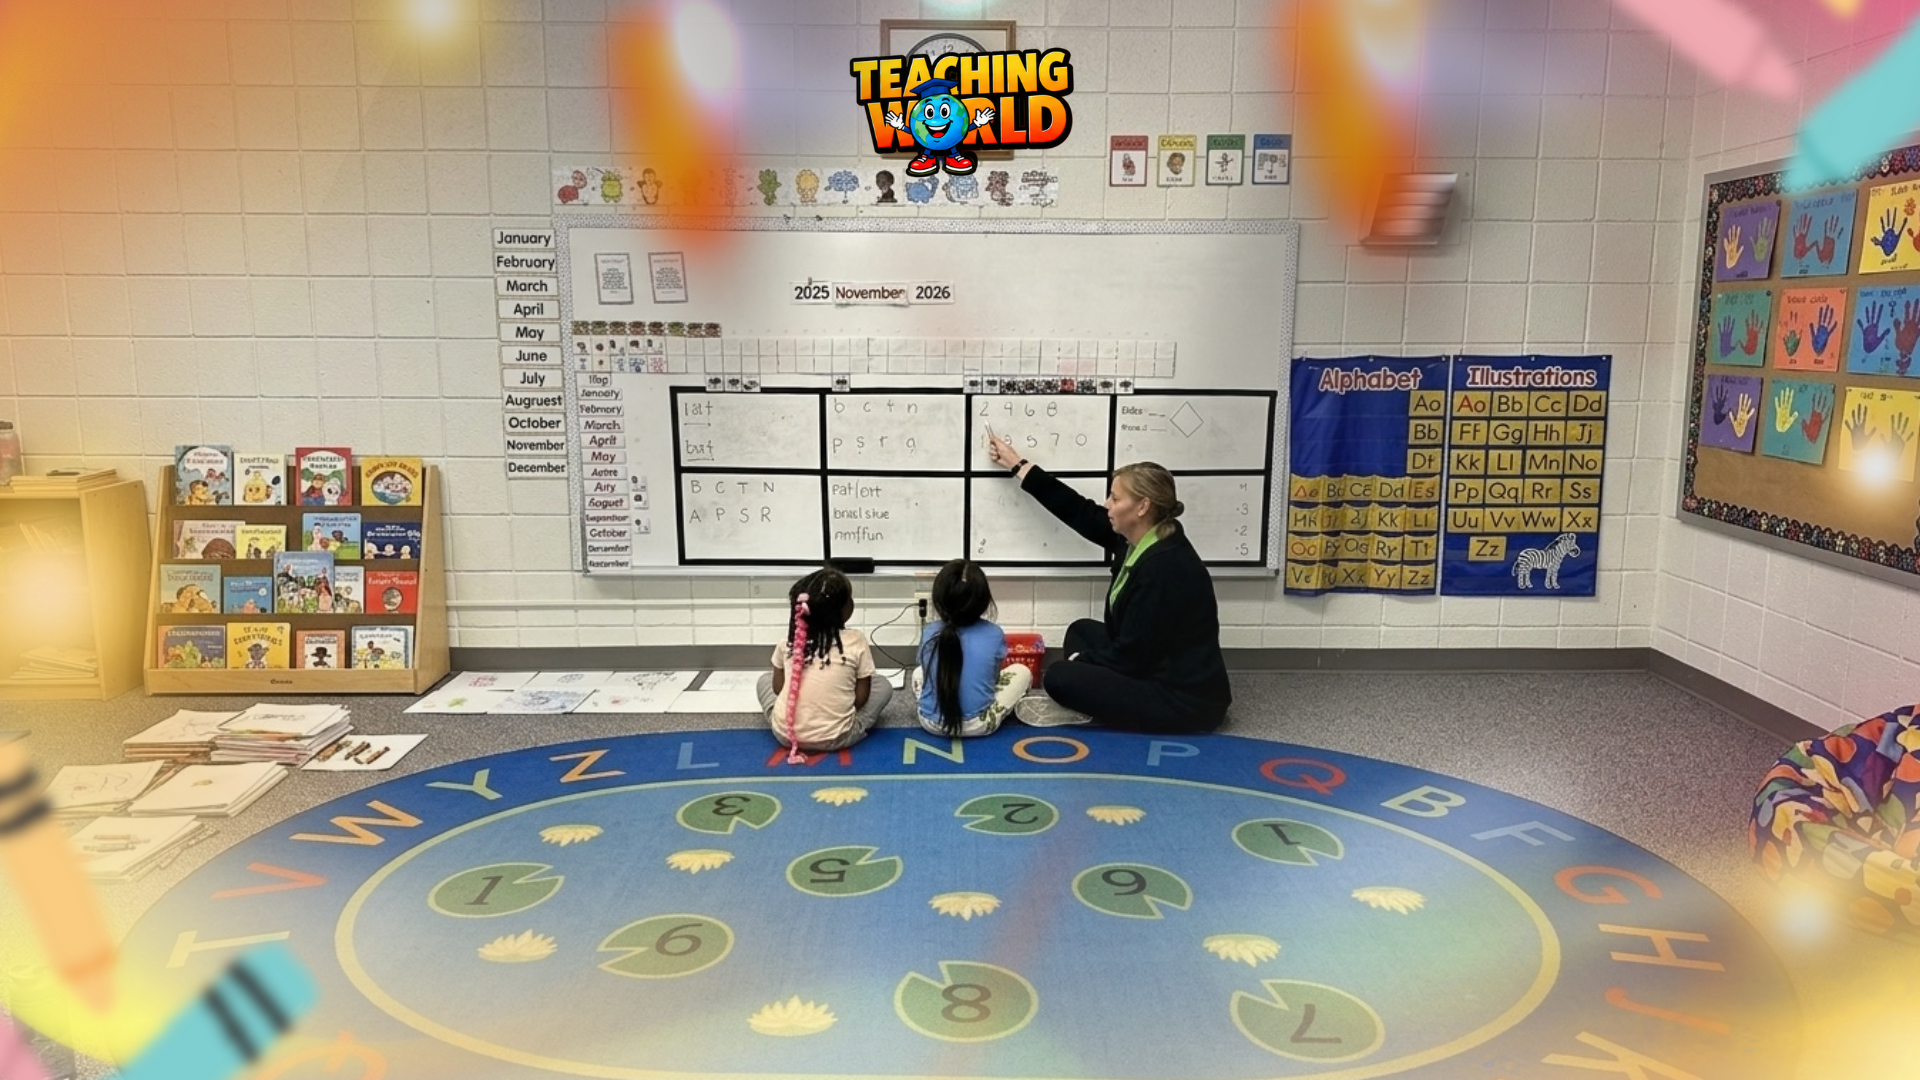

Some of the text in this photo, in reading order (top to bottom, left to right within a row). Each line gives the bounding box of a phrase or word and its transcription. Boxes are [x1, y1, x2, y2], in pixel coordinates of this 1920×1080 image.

[497, 231, 551, 247] January
[496, 255, 555, 271] February
[506, 280, 548, 292] March
[794, 285, 951, 300] 2025 November 2026
[513, 303, 544, 318] April
[515, 326, 544, 341] May
[515, 350, 548, 362] June
[520, 372, 545, 386] July
[1319, 367, 1422, 394] Alphabet
[505, 395, 563, 409] Augruest
[834, 398, 845, 414] b
[907, 403, 918, 413] n
[980, 402, 989, 416] 2
[1024, 404, 1035, 416] 6
[1047, 402, 1057, 416] 8
[1498, 395, 1523, 412] Bb
[1534, 395, 1562, 412] Cc
[1573, 394, 1602, 412] Dd
[508, 417, 562, 429] October
[1051, 433, 1059, 446] 7
[1414, 424, 1438, 440] Bb
[1459, 423, 1593, 444] Ff Gg Hh Jj
[507, 440, 565, 451] November
[591, 452, 616, 463] May
[1456, 453, 1481, 471] Kk
[1569, 453, 1598, 470] No
[508, 462, 565, 473] December
[691, 480, 774, 494] B C T N
[1454, 482, 1592, 503] Pp Qq Rr Ss
[689, 506, 771, 523] A P S R
[1378, 512, 1398, 527] Kk
[1453, 511, 1592, 528] Uu Vv Ww Xx
[1475, 540, 1500, 557] Zz
[1375, 569, 1396, 587] Yy
[1408, 570, 1430, 585] Zz
[676, 742, 720, 770] L
[902, 736, 965, 765] N
[1146, 740, 1201, 766] P
[549, 749, 626, 784] Z
[425, 769, 503, 801] Y
[1259, 757, 1347, 796] Q
[1380, 785, 1467, 818] B
[1002, 803, 1039, 825] 2
[288, 800, 424, 847] W
[211, 861, 329, 901] V
[1554, 865, 1664, 905] G
[465, 875, 504, 907] 1
[1597, 923, 1725, 972] H
[941, 982, 991, 1024] 8
